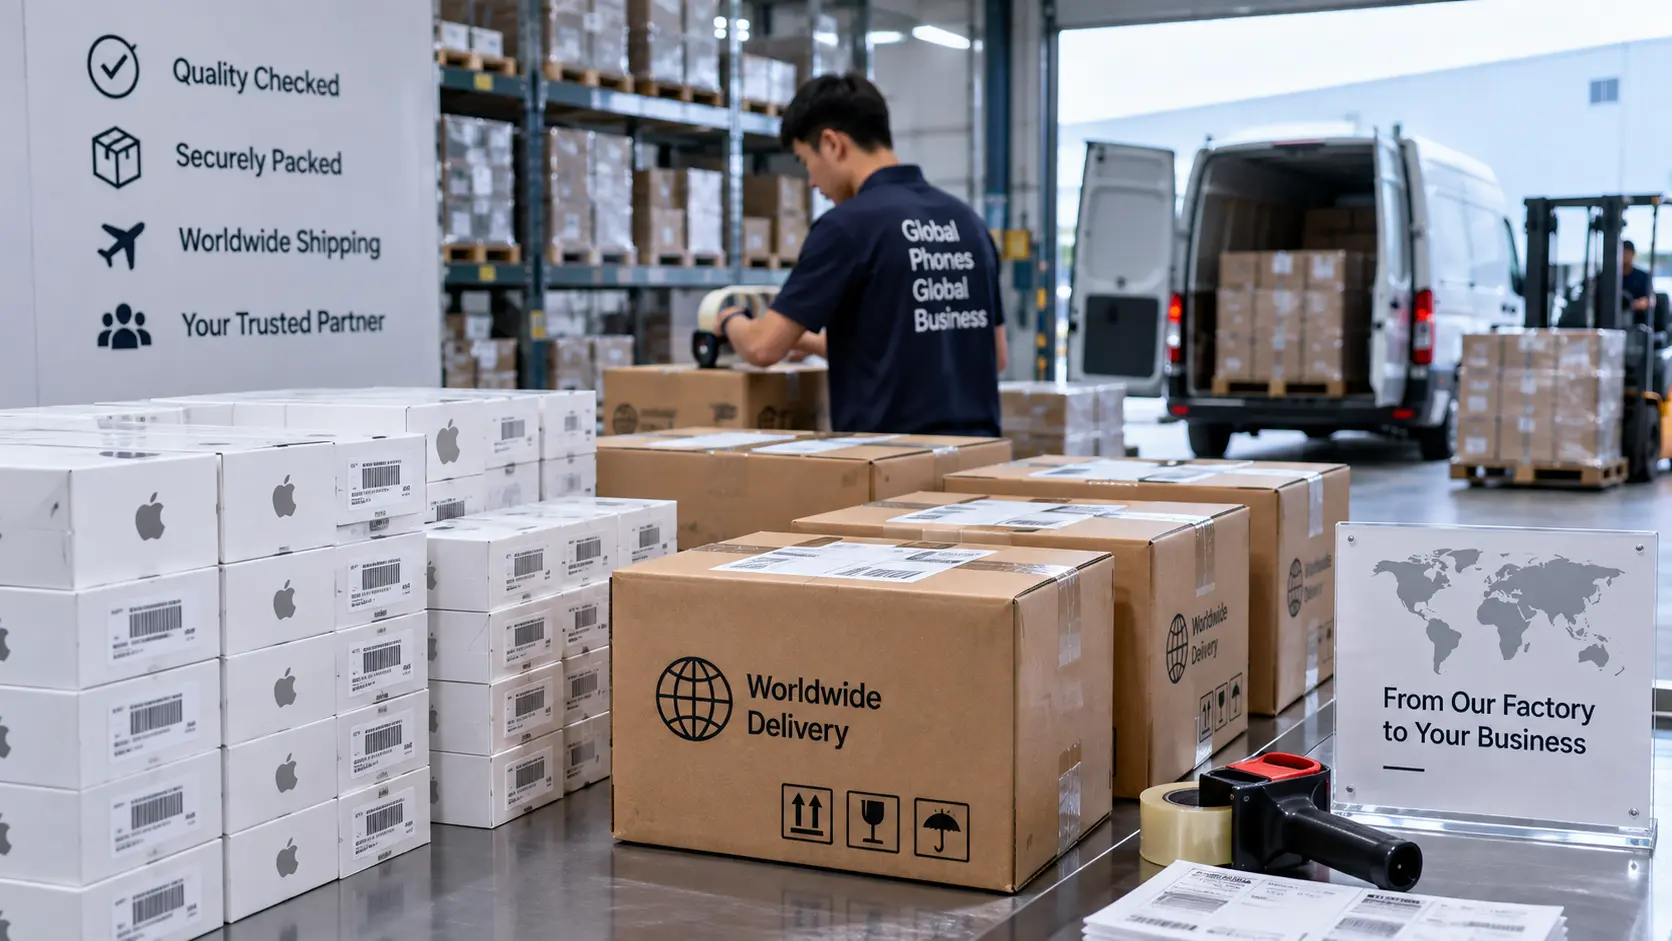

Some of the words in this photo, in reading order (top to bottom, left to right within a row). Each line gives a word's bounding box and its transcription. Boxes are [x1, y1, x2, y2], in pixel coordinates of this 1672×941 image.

[173, 57, 248, 94] Quality
[254, 66, 340, 97] Checked
[176, 143, 266, 177] Securely
[272, 149, 342, 176] Packed
[179, 227, 291, 254] Worldwide
[296, 229, 381, 260] Shipping
[901, 219, 960, 243] Global
[909, 247, 975, 272] Phones
[912, 276, 970, 302] Global
[182, 312, 231, 337] Your
[236, 309, 312, 335] Trusted
[317, 310, 386, 332] Partner
[914, 307, 988, 334] Business
[746, 674, 882, 712] Worldwide
[1383, 687, 1444, 712] From
[1451, 690, 1497, 716] Our
[1503, 694, 1596, 726] Factory
[748, 709, 850, 750] Delivery
[1383, 720, 1408, 743] to
[1415, 721, 1471, 746] Your
[1478, 726, 1587, 755] Business
